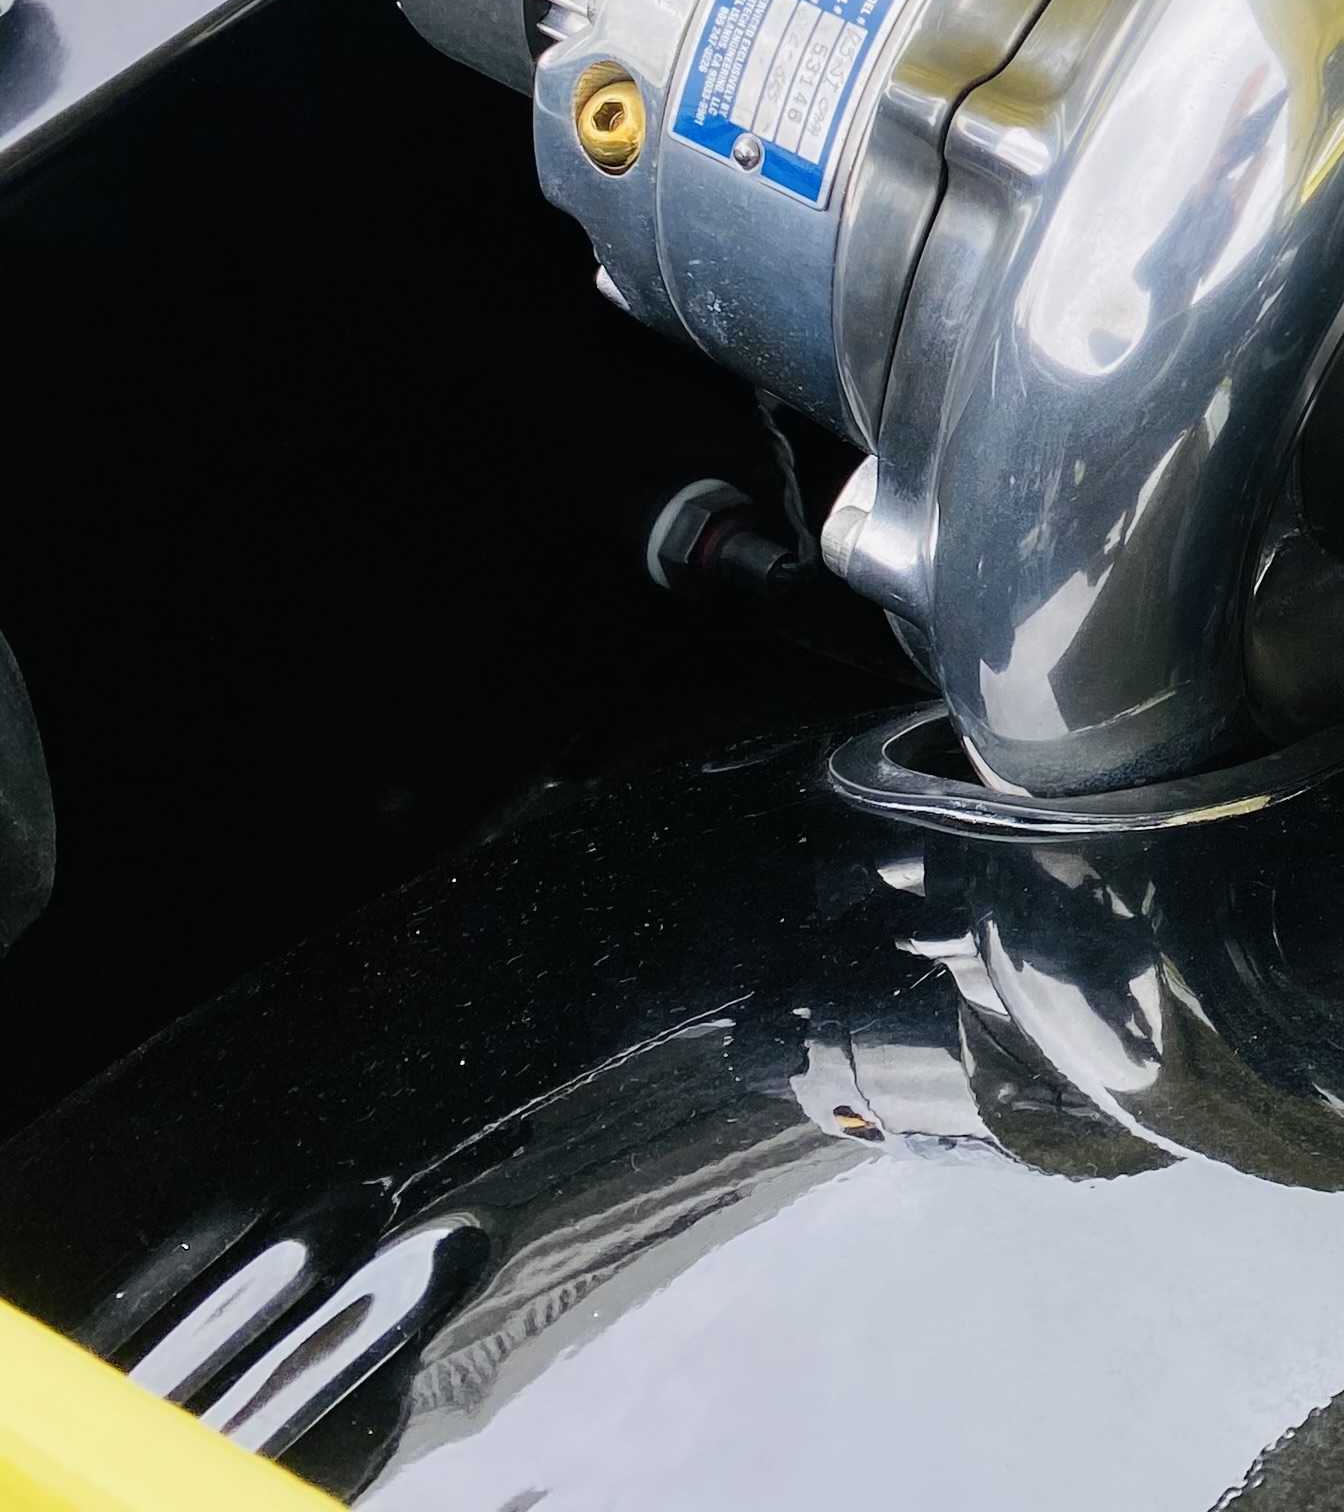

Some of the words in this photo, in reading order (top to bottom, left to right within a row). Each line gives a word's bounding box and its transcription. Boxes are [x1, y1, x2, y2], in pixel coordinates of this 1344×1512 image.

[710, 52, 723, 69] CA
[721, 37, 752, 103] EXCLUSIVELY
[785, 41, 828, 125] 53146
[707, 95, 721, 116] LLC
[717, 101, 730, 118] BY
